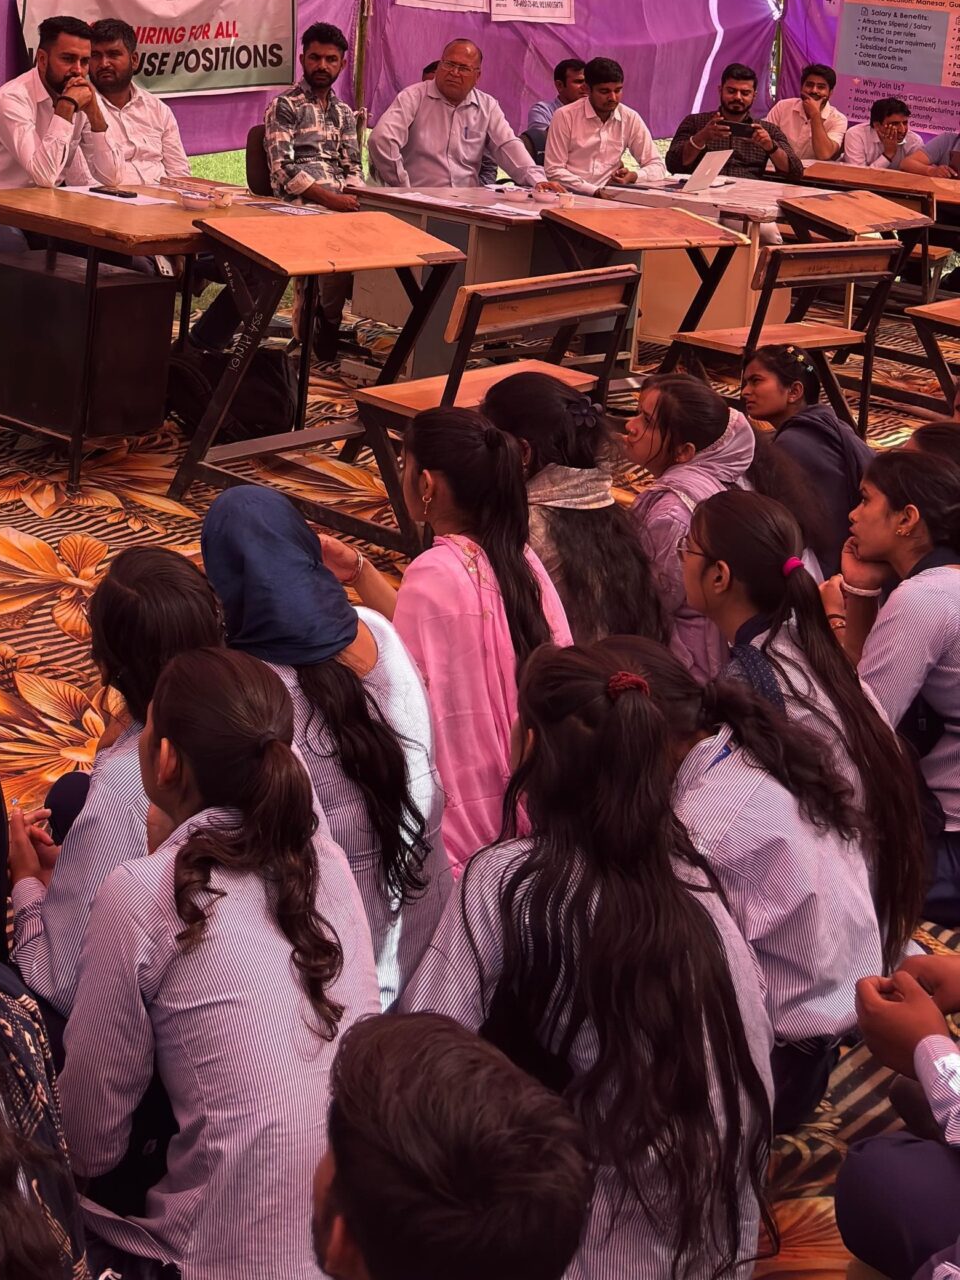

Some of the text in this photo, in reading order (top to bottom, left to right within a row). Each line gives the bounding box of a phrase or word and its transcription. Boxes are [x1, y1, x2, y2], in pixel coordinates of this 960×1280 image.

[871, 9, 892, 18] Salary
[862, 18, 888, 26] Attractive
[888, 20, 909, 29] Stipend
[913, 23, 932, 31] Salary
[188, 23, 211, 42] FOR
[214, 20, 239, 40] ALL
[902, 30, 916, 38] rules
[860, 34, 885, 43] Overtime
[859, 43, 912, 54] Subsidized Canteen
[171, 43, 283, 75] POSITIONS
[877, 53, 897, 61] Growth
[890, 63, 908, 72] Group
[862, 79, 905, 91] Why Join Us?
[869, 89, 881, 97] with
[937, 98, 950, 106] Fuel
[912, 105, 954, 116] manufacturing
[909, 121, 928, 129] Group
